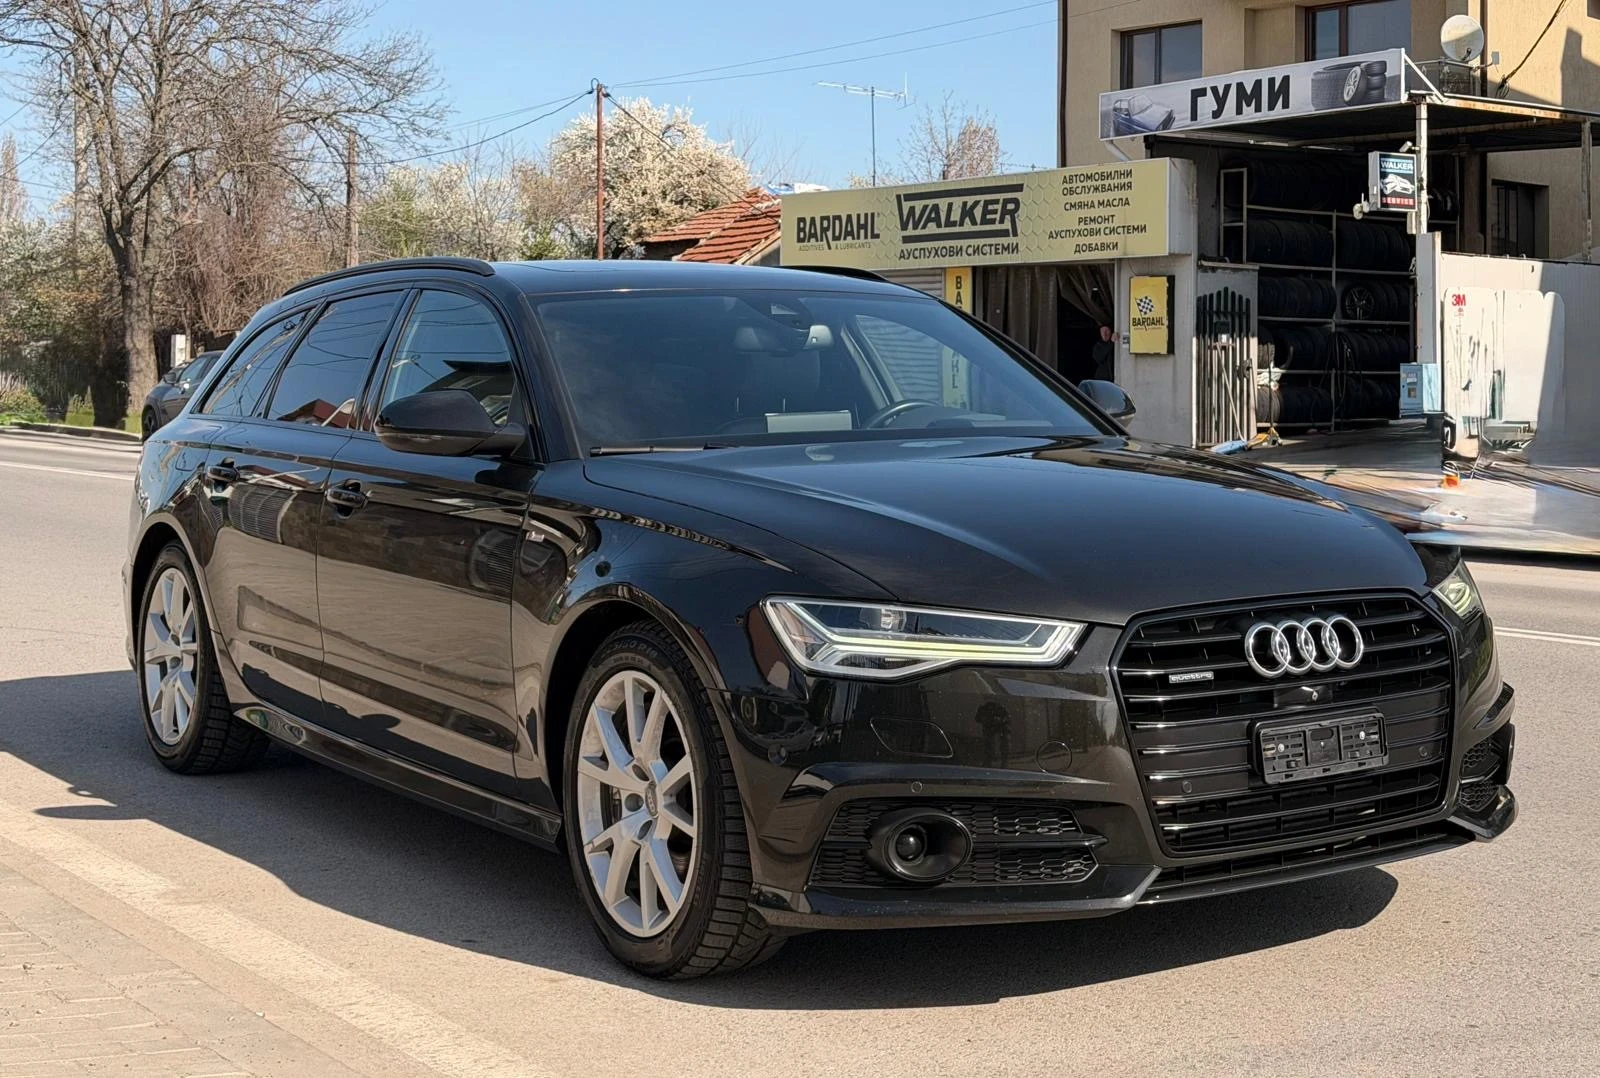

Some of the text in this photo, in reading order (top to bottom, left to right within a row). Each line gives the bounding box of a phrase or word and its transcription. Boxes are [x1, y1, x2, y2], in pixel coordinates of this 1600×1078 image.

[1189, 75, 1290, 122] ГУМИ
[1381, 161, 1413, 170] WALKER
[1062, 168, 1133, 185] АВТОМОБИЛНИ
[1062, 181, 1133, 196] ОБСЛУЖВАНИЯ
[1063, 197, 1131, 211] СМЯНА МАСЛА
[896, 194, 1021, 238] WALKER
[1078, 214, 1116, 226] РЕМОНТ
[796, 212, 880, 250] BARDAHL
[1048, 224, 1147, 240] АУСПУХОВИ СИСТЕМИ
[898, 243, 1019, 261] АУСПУХОВИ СИСТЕМИ
[1073, 242, 1119, 254] ДОБАВКИ
[1452, 294, 1466, 306] 3M
[1132, 316, 1165, 331] BARDAHL
